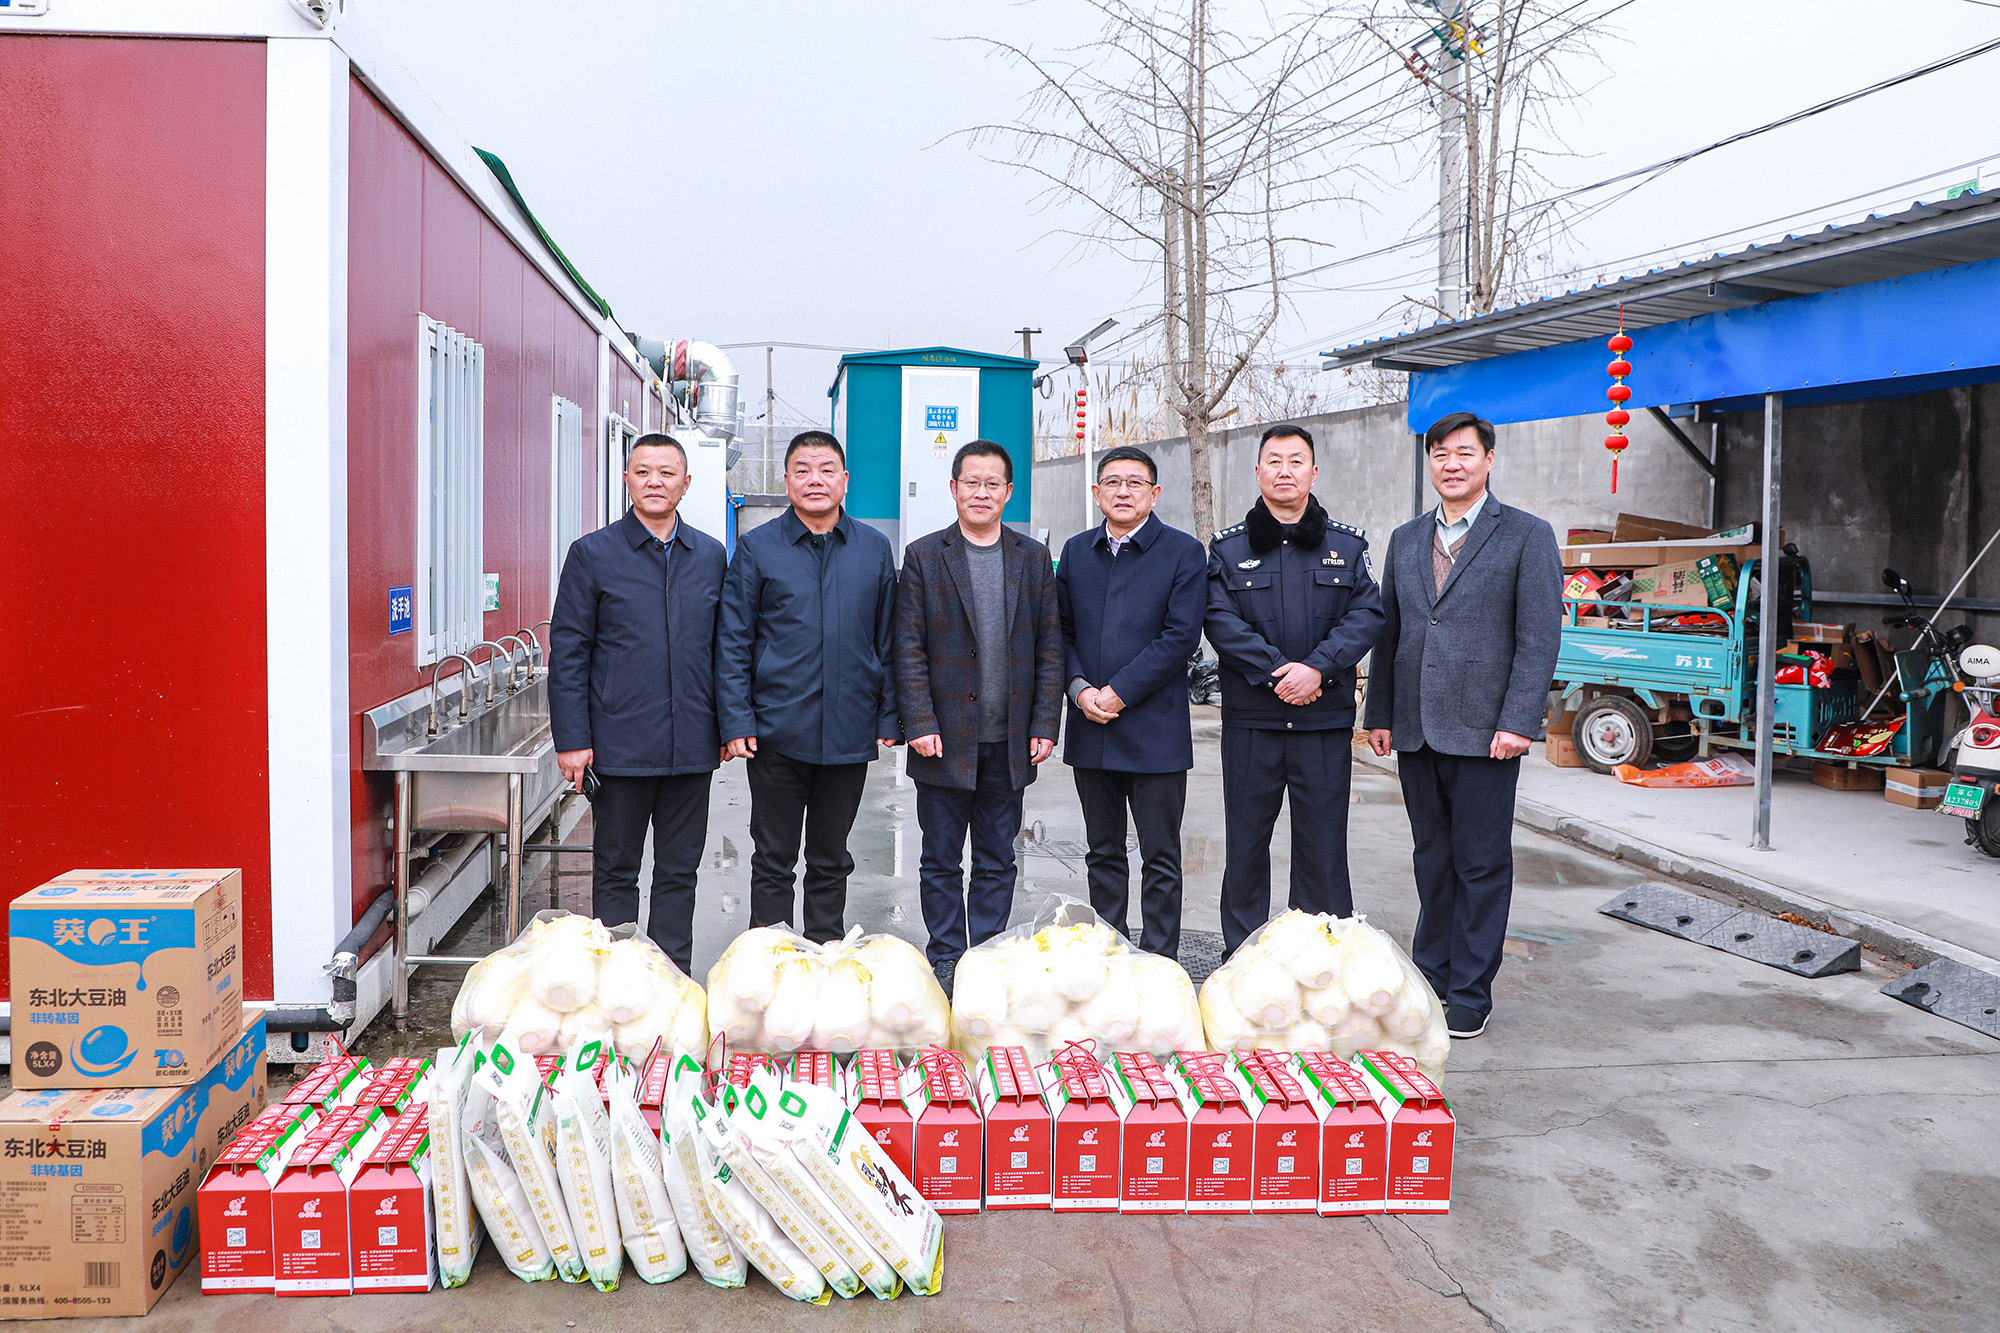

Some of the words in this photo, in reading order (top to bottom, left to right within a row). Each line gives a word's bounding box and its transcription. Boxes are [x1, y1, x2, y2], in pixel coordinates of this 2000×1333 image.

[1967, 657, 1990, 665] AIMA
[29, 988, 127, 1007] 东北大豆油
[29, 1012, 80, 1025] 非转基因
[32, 1060, 56, 1068] 5LX4
[4, 1138, 107, 1159] 东北大豆油
[30, 1164, 83, 1177] 非转基因
[19, 1284, 41, 1292] 5LX4
